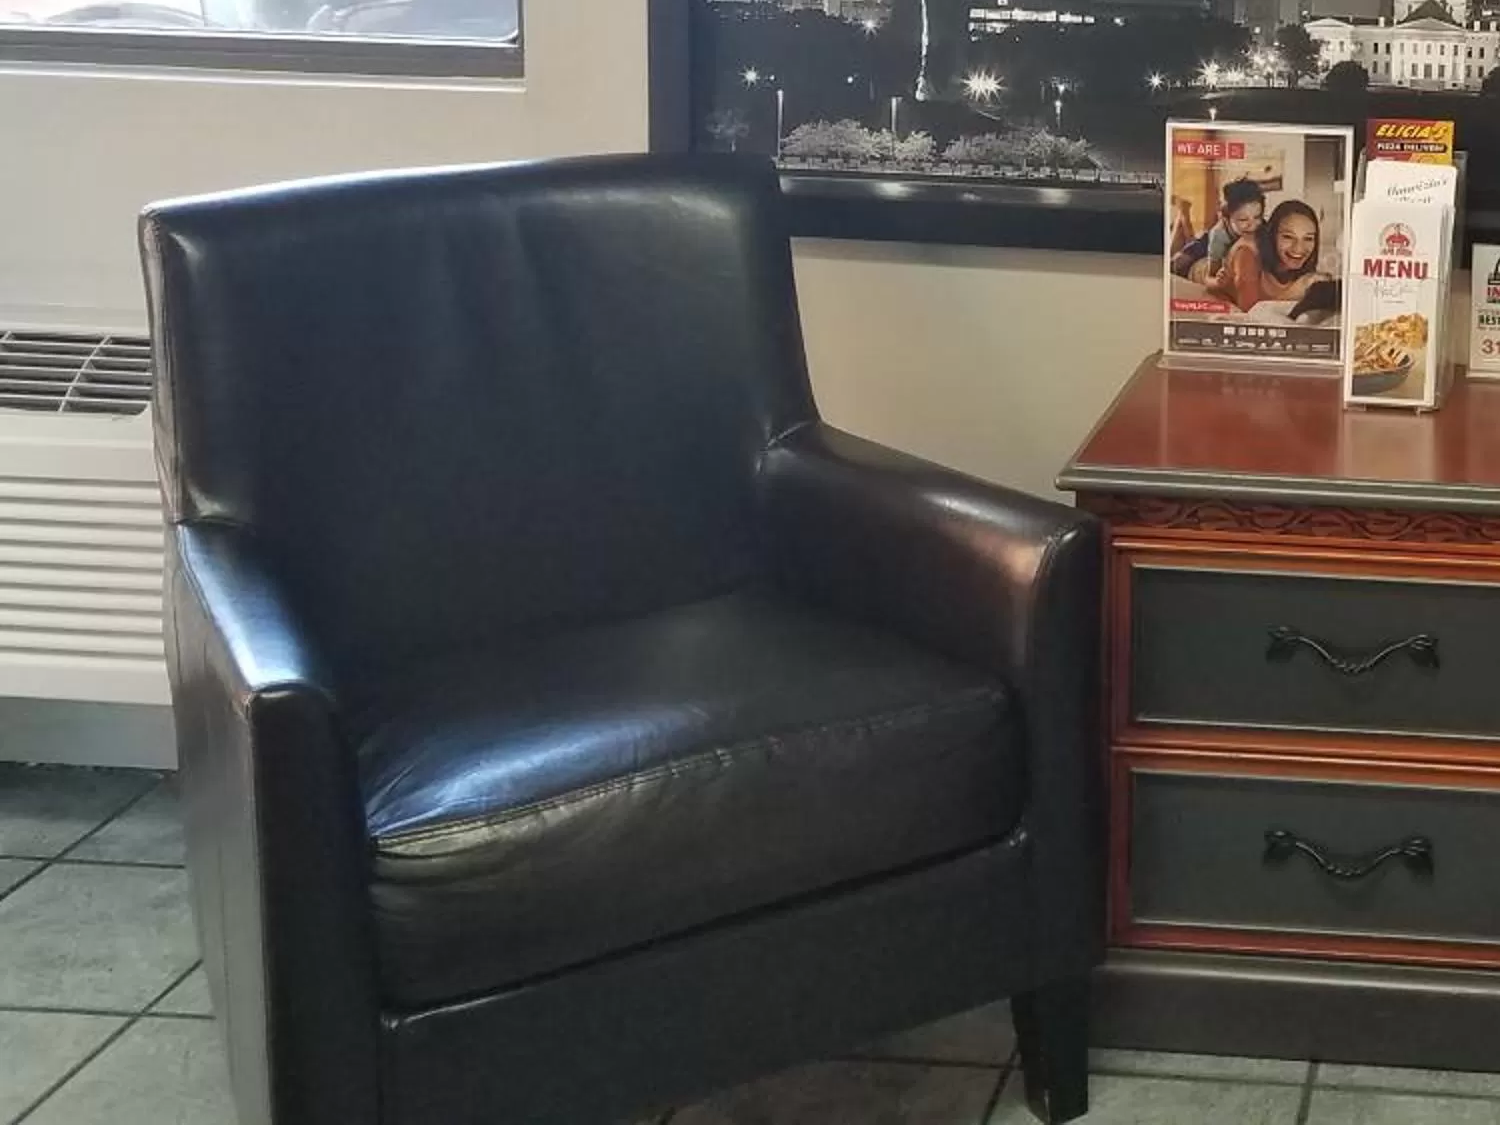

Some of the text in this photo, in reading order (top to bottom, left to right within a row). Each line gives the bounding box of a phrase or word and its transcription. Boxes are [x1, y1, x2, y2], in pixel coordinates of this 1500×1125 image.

[1375, 123, 1448, 139] ELICIA'S
[1197, 144, 1221, 156] ARE
[1363, 258, 1429, 280] MENU
